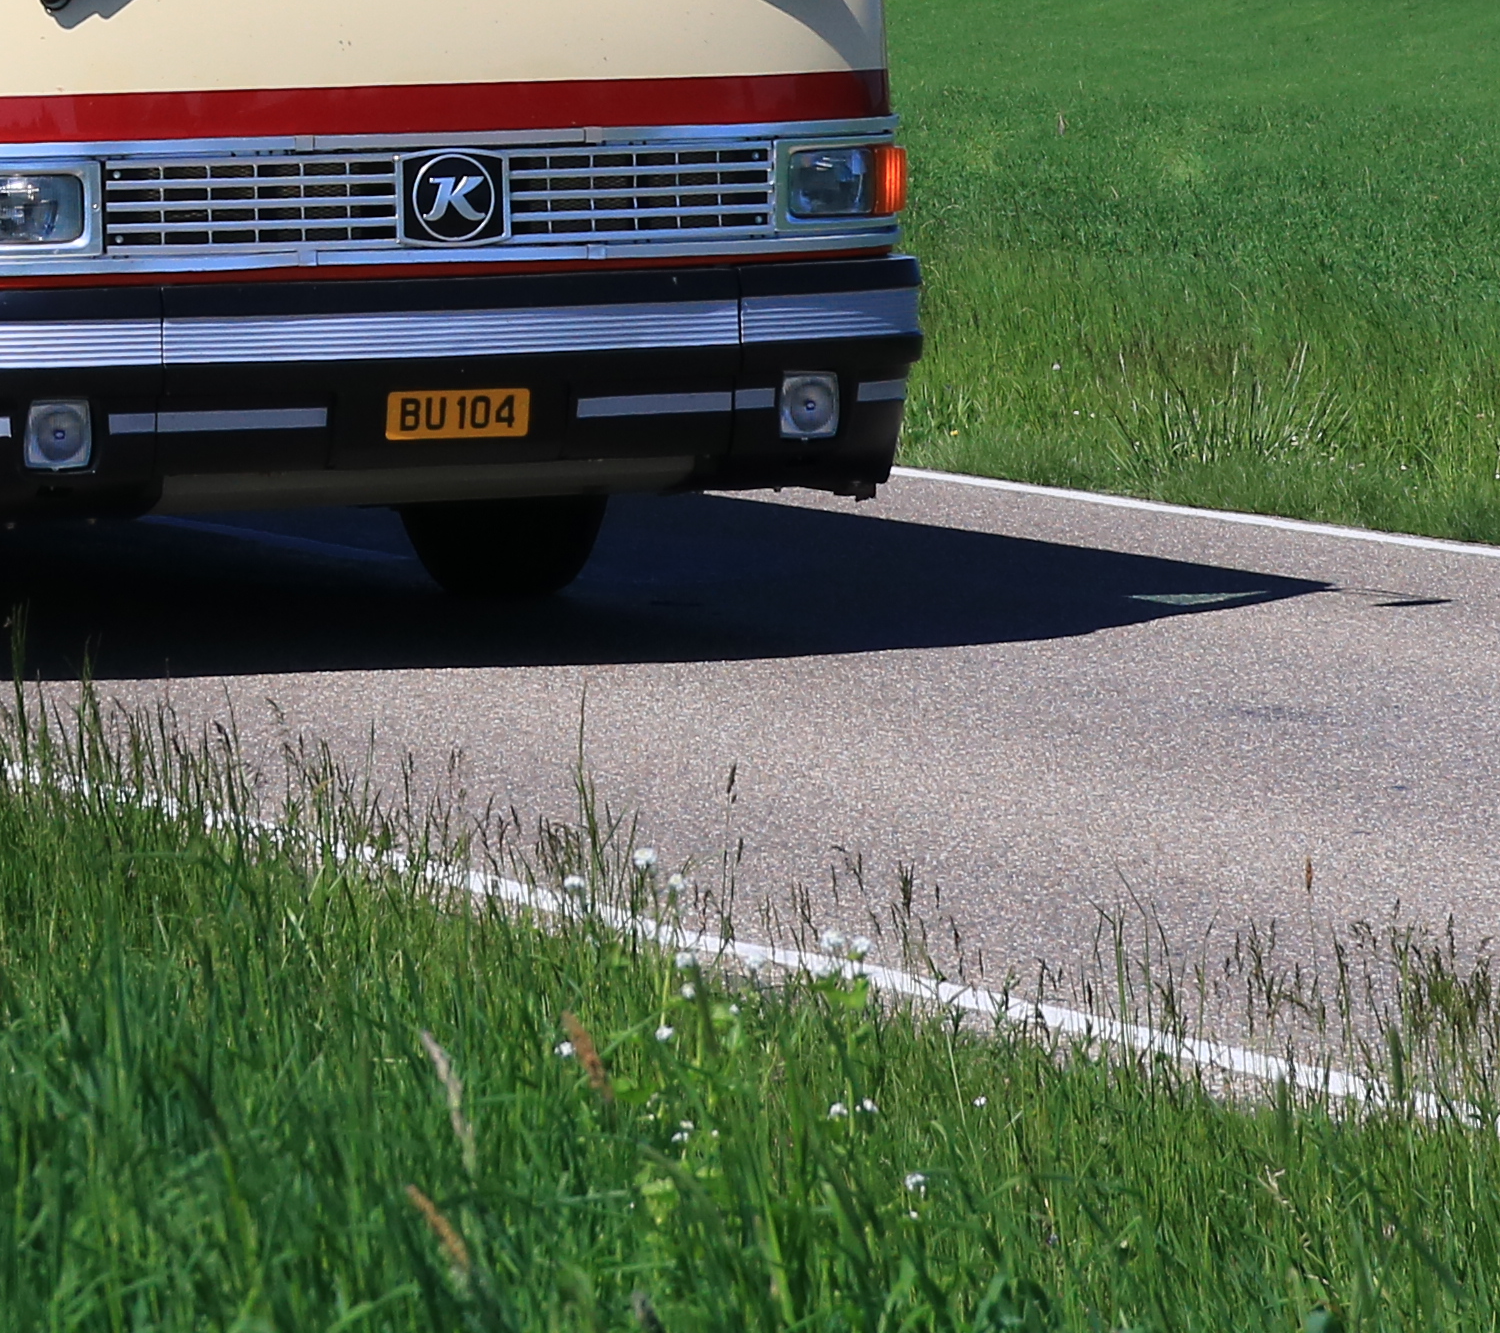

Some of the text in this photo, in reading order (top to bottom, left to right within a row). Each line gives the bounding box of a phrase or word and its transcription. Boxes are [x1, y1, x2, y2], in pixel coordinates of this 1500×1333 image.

[422, 175, 487, 222] K
[399, 394, 516, 432] BU 104
